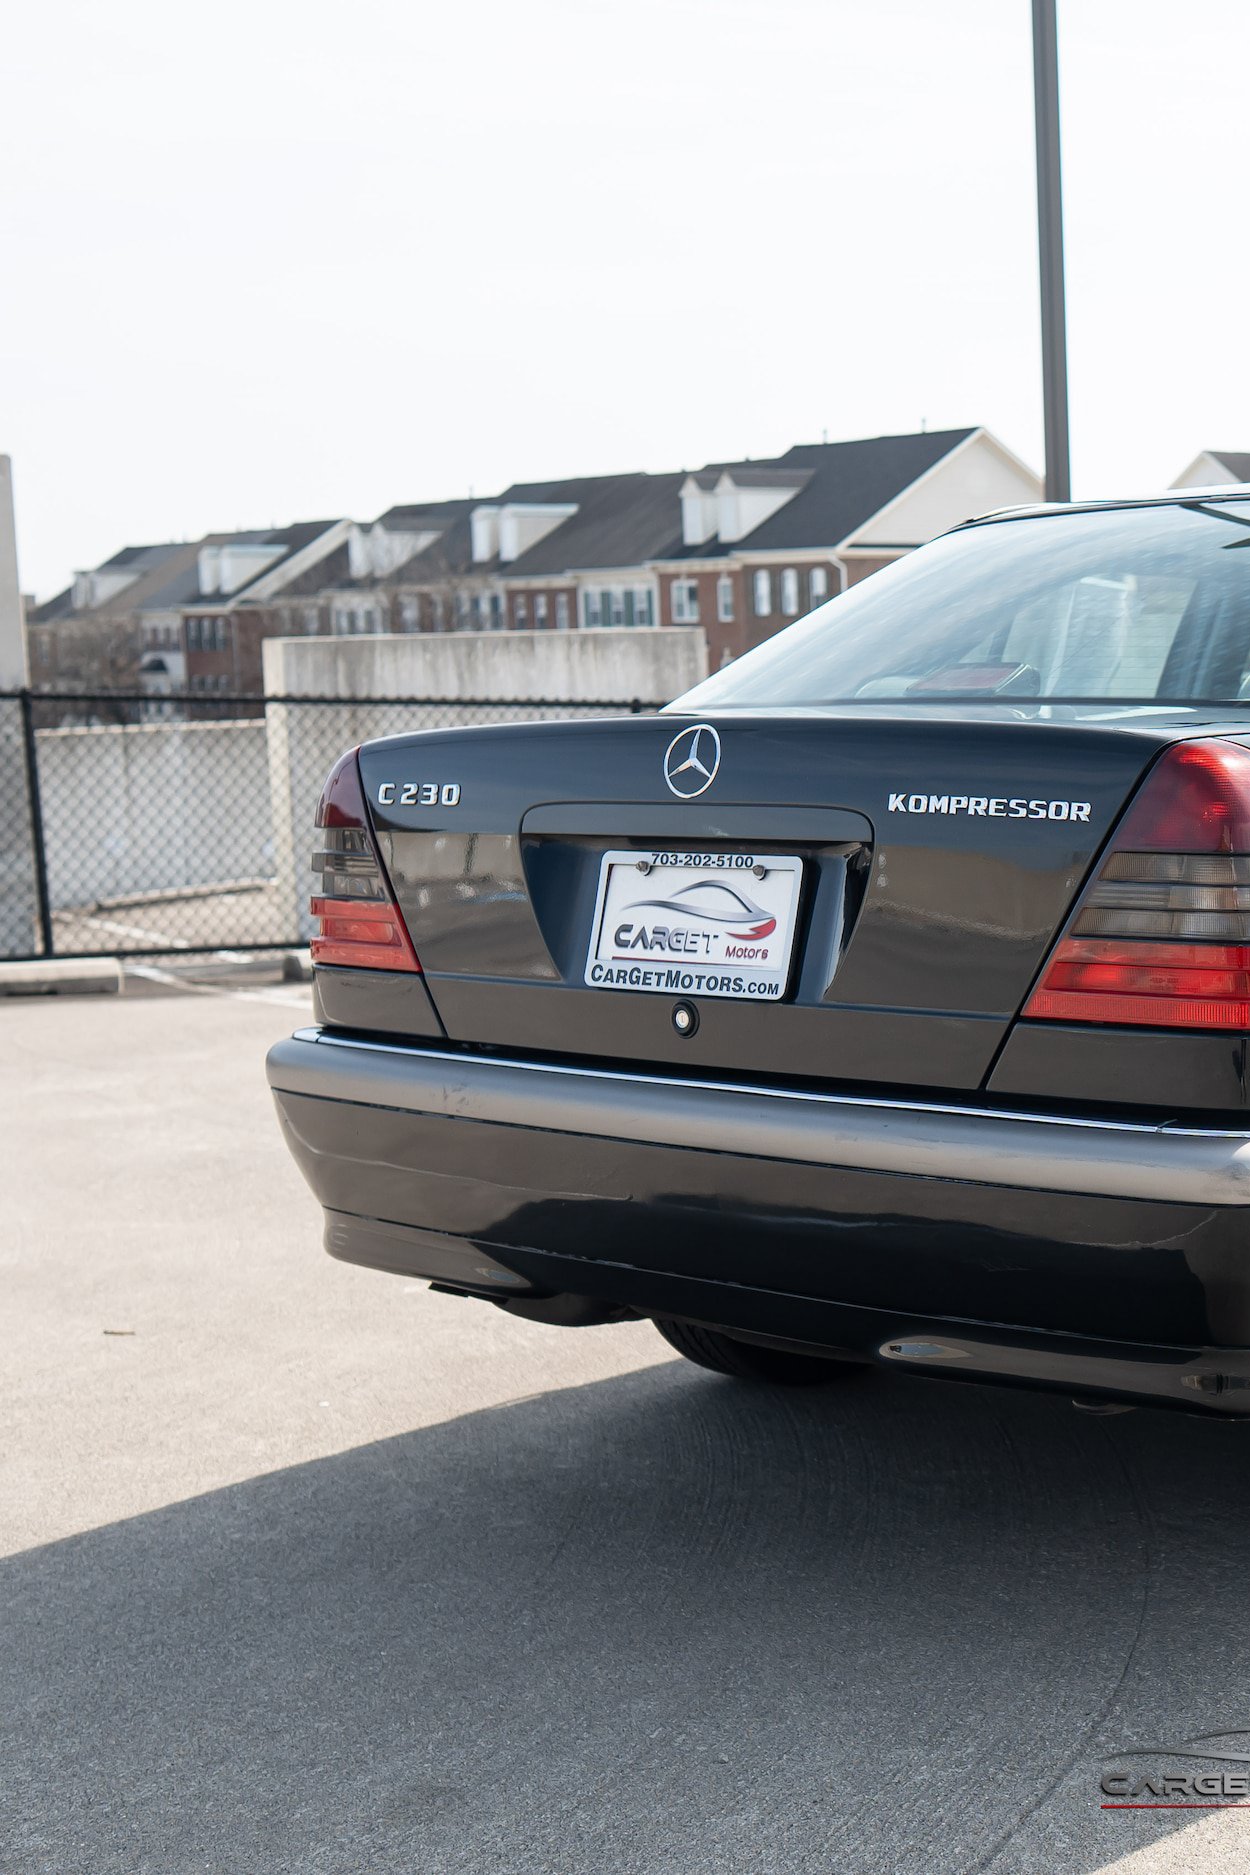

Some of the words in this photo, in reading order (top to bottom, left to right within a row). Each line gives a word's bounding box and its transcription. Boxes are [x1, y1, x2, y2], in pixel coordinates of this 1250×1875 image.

[378, 782, 396, 805] C
[400, 782, 461, 806] 230
[888, 793, 1092, 822] KOMPRESSOR
[651, 853, 754, 868] 703-202-5100
[614, 923, 719, 954] CARGET
[725, 945, 768, 960] Motors
